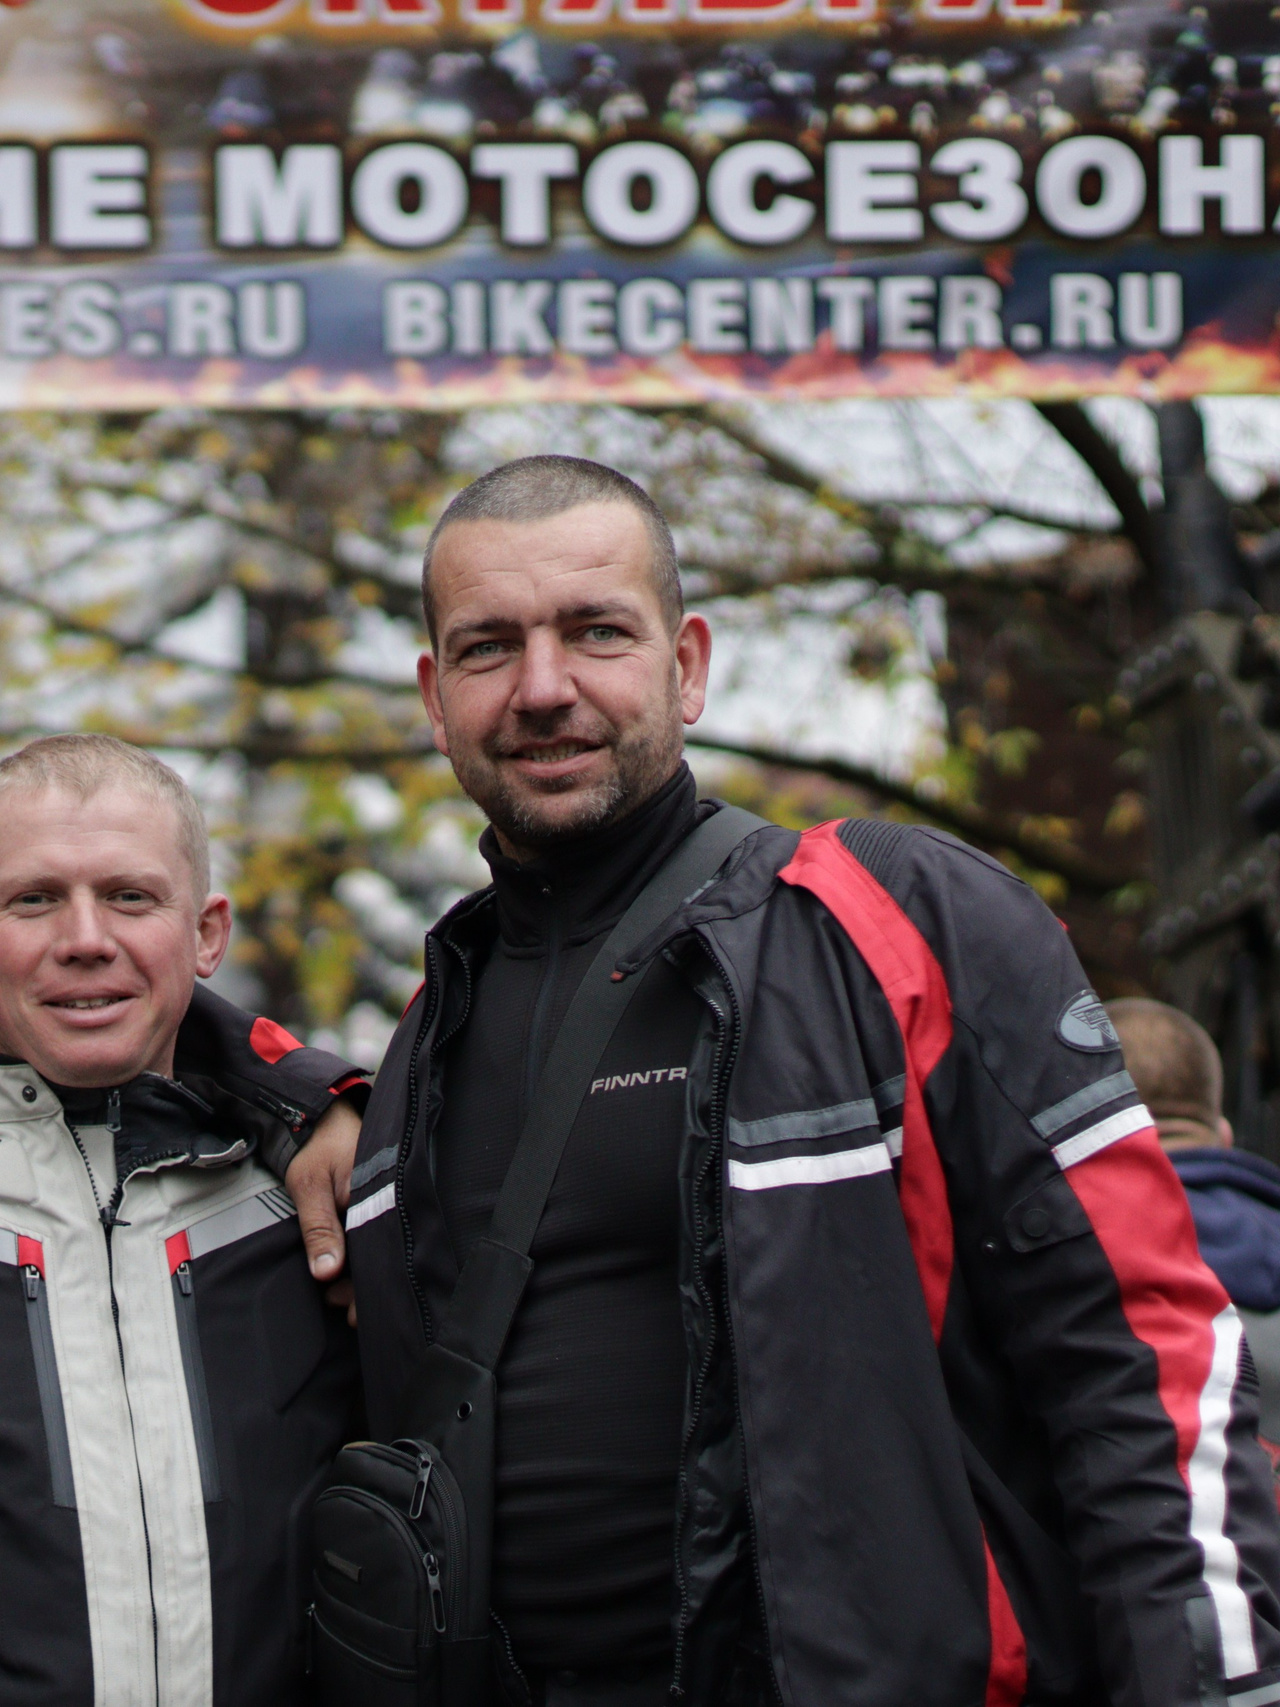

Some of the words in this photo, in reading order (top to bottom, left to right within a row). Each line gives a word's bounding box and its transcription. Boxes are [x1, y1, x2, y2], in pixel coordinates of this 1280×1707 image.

[214, 133, 1280, 248] МОТОСЕЗОН
[382, 270, 1186, 357] BIKECENTER.RU
[590, 1066, 688, 1095] FINNTR
